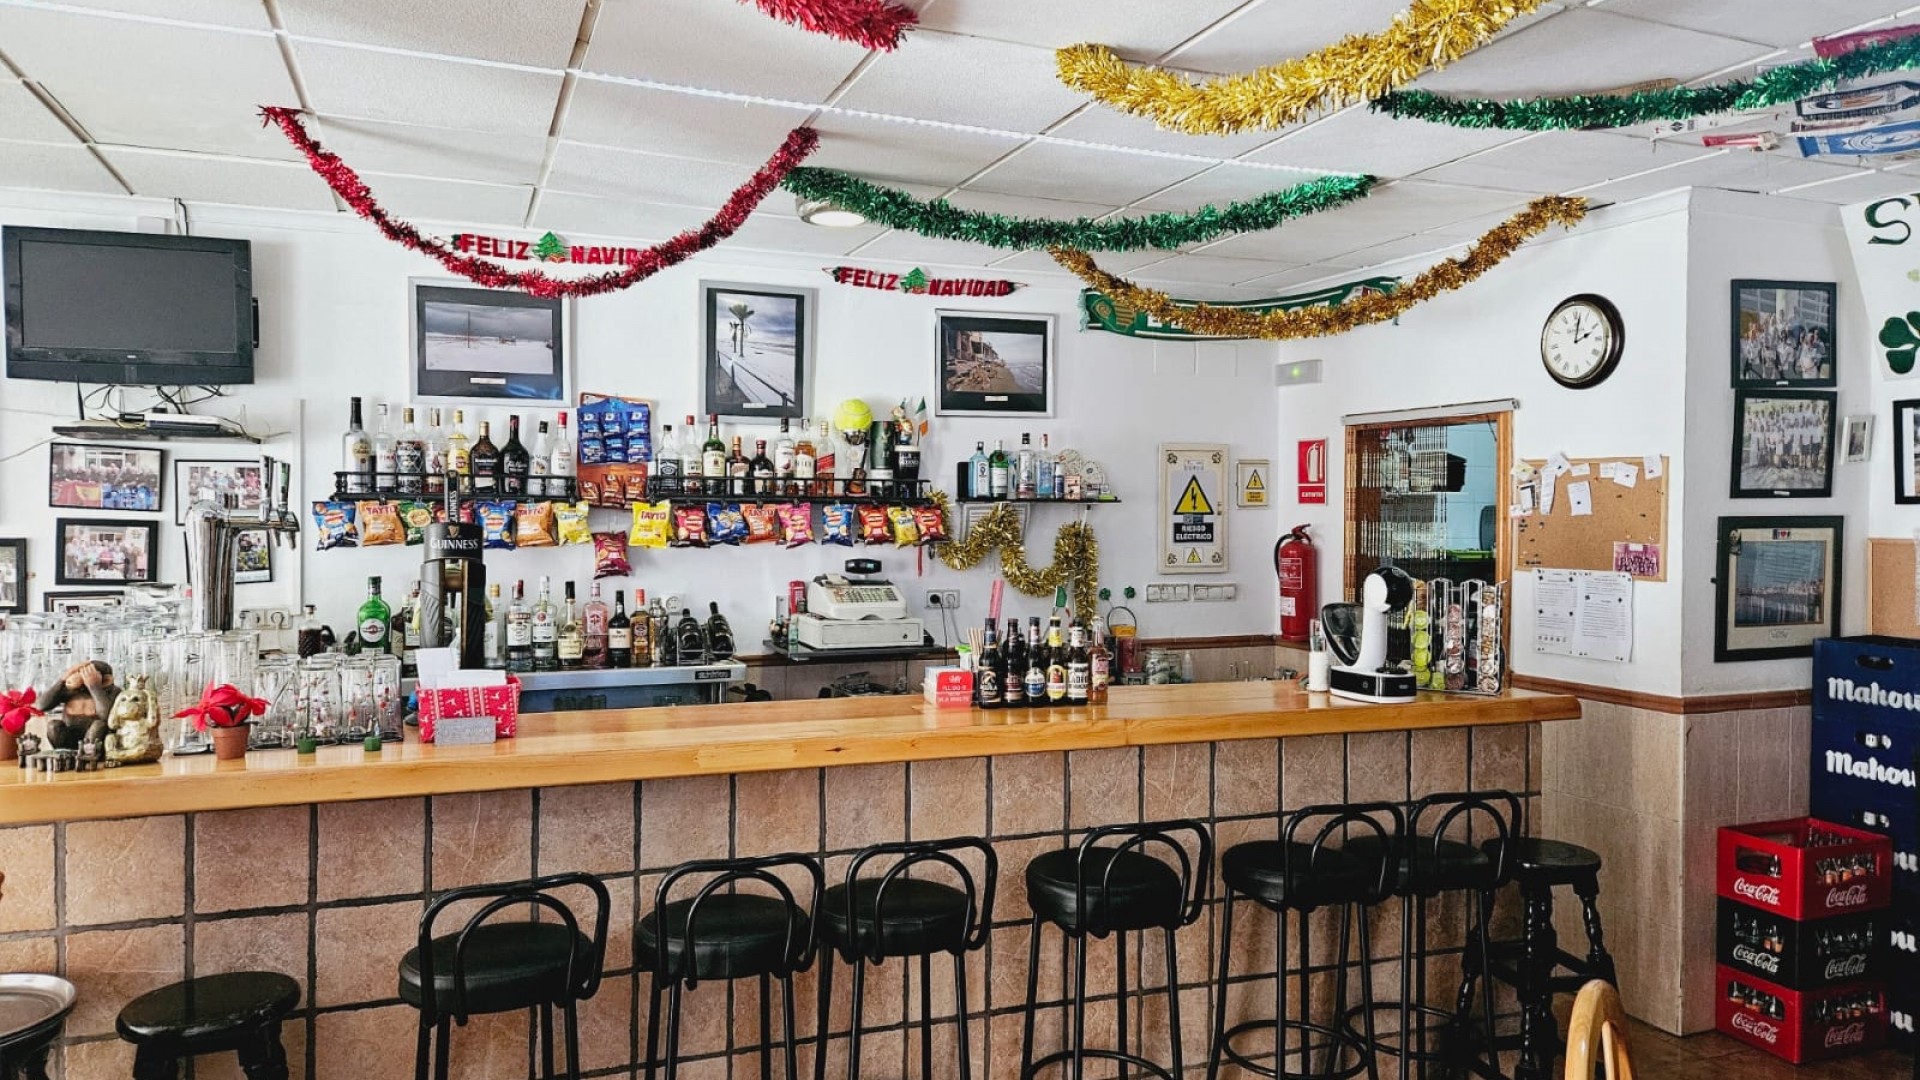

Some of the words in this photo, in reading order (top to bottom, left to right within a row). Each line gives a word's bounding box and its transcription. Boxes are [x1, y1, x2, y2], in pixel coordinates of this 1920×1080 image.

[1864, 193, 1920, 245] S
[460, 233, 530, 261] FELIZ
[571, 245, 645, 266] NAVID
[839, 267, 899, 291] FELIZ
[929, 278, 1010, 297] NAVIDAD
[641, 510, 667, 520] TAYTO
[430, 538, 479, 550] GUINNESS
[1827, 677, 1920, 712] Mahou
[1825, 749, 1916, 788] Mahou
[1734, 877, 1781, 906] Coca-Cola
[1733, 943, 1781, 974] Coca-Cola
